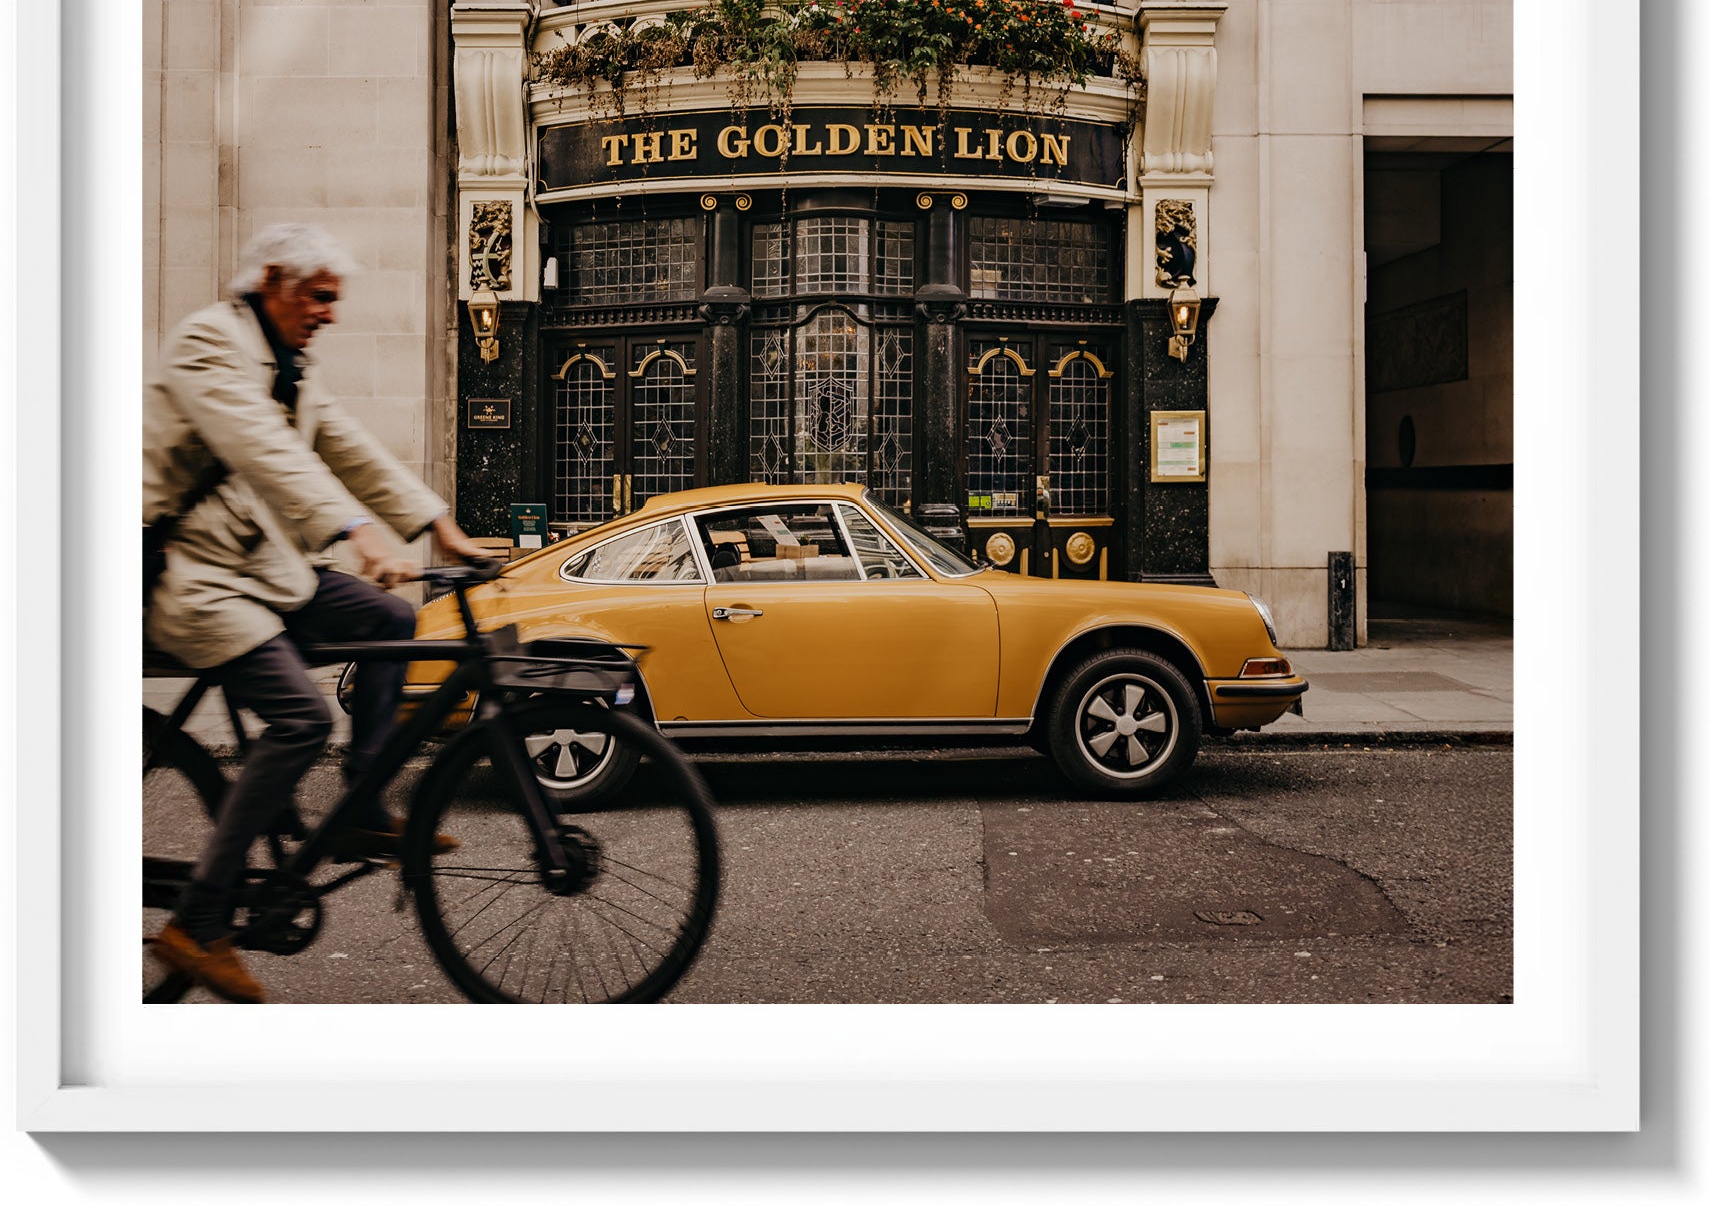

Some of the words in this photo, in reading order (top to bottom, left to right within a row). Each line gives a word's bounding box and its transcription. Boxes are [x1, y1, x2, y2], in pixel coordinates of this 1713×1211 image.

[601, 128, 698, 166] THE
[716, 123, 937, 158] GOLDEN
[953, 127, 1072, 166] LION
[1340, 578, 1346, 589] 1
